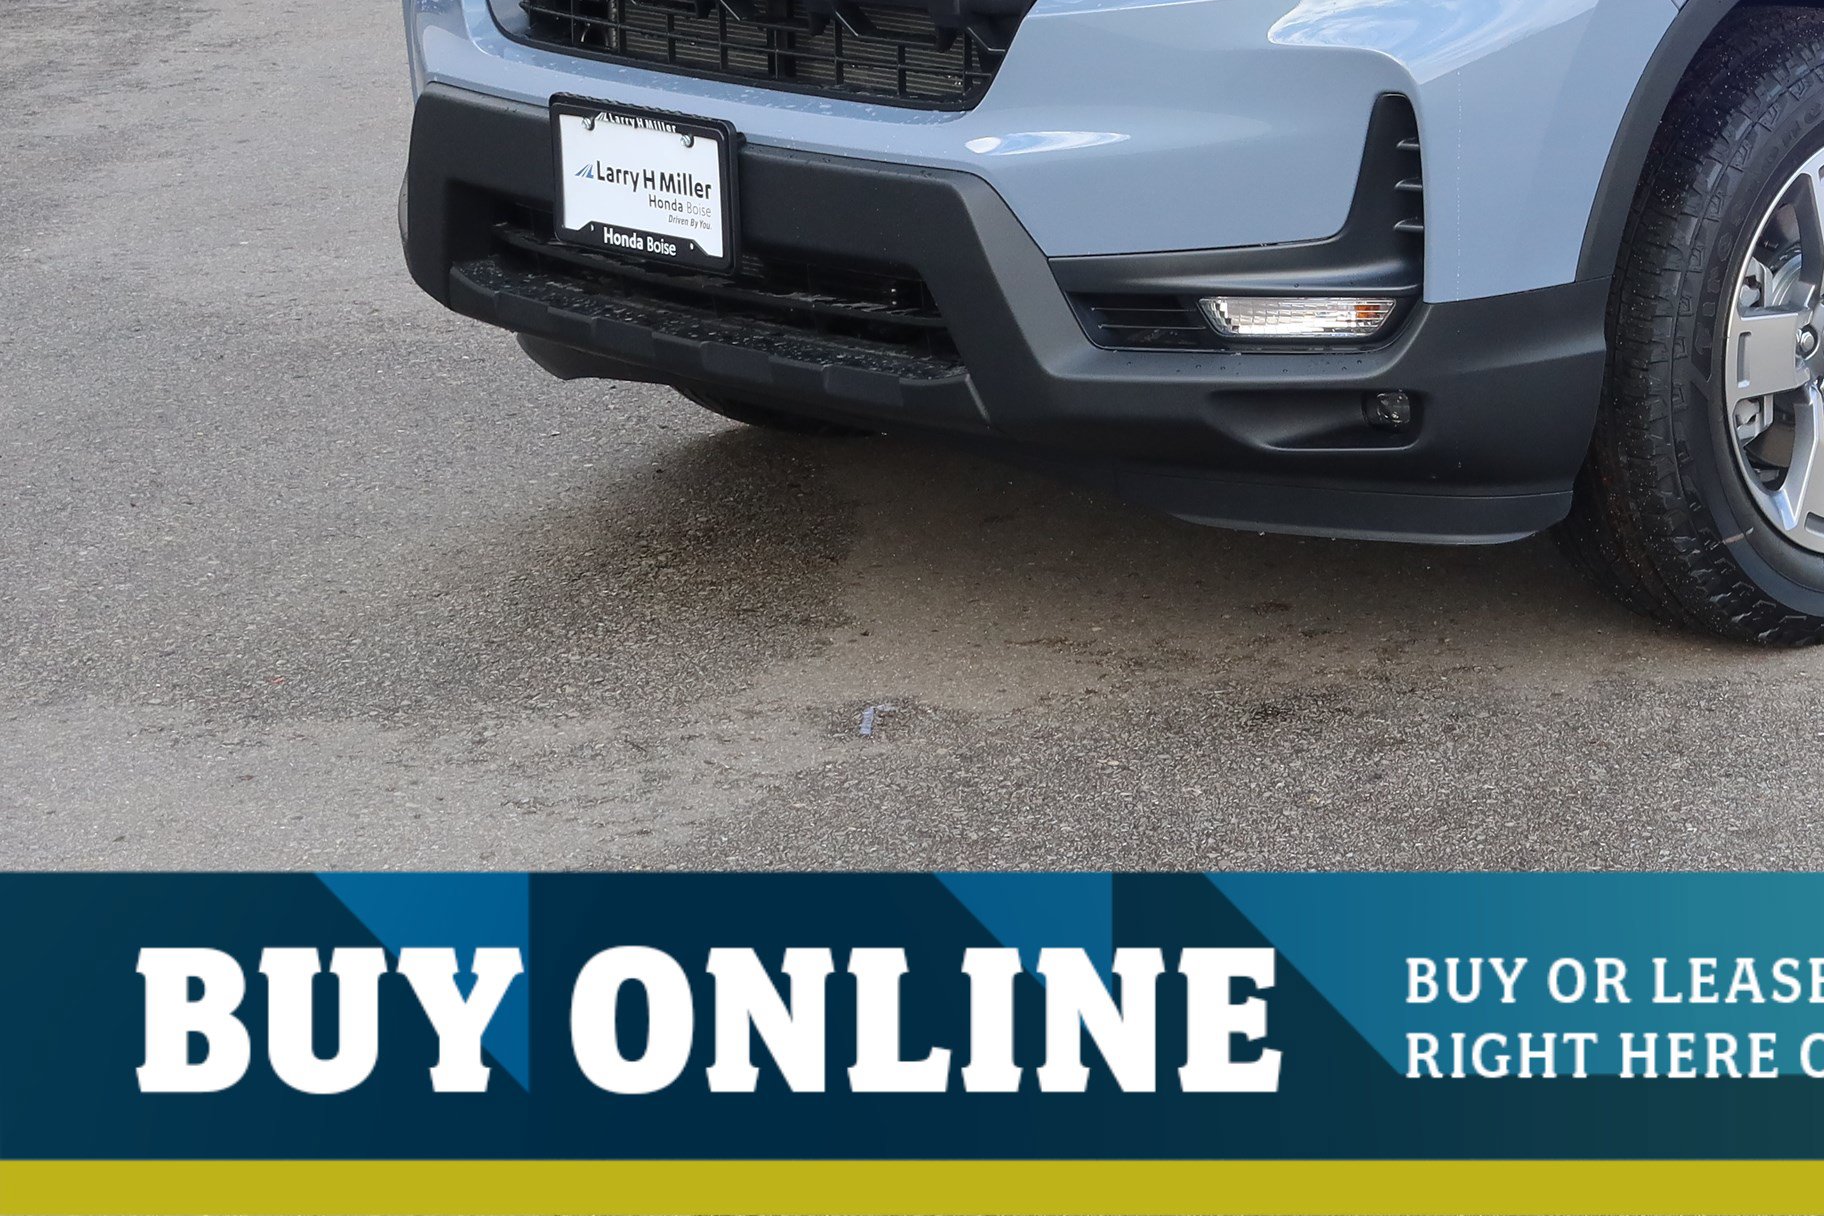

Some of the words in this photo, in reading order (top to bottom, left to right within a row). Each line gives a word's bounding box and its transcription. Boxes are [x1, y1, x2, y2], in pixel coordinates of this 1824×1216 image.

[609, 113, 635, 128] Larry
[636, 117, 644, 128] H
[645, 119, 676, 133] Miller
[597, 160, 639, 193] Larry
[643, 169, 655, 190] H
[660, 172, 711, 199] Miller
[649, 194, 683, 212] Honda
[686, 201, 712, 218] Boise
[668, 215, 689, 225] Driven
[690, 217, 699, 229] By
[603, 227, 643, 250] Honda
[646, 236, 677, 256] Boise
